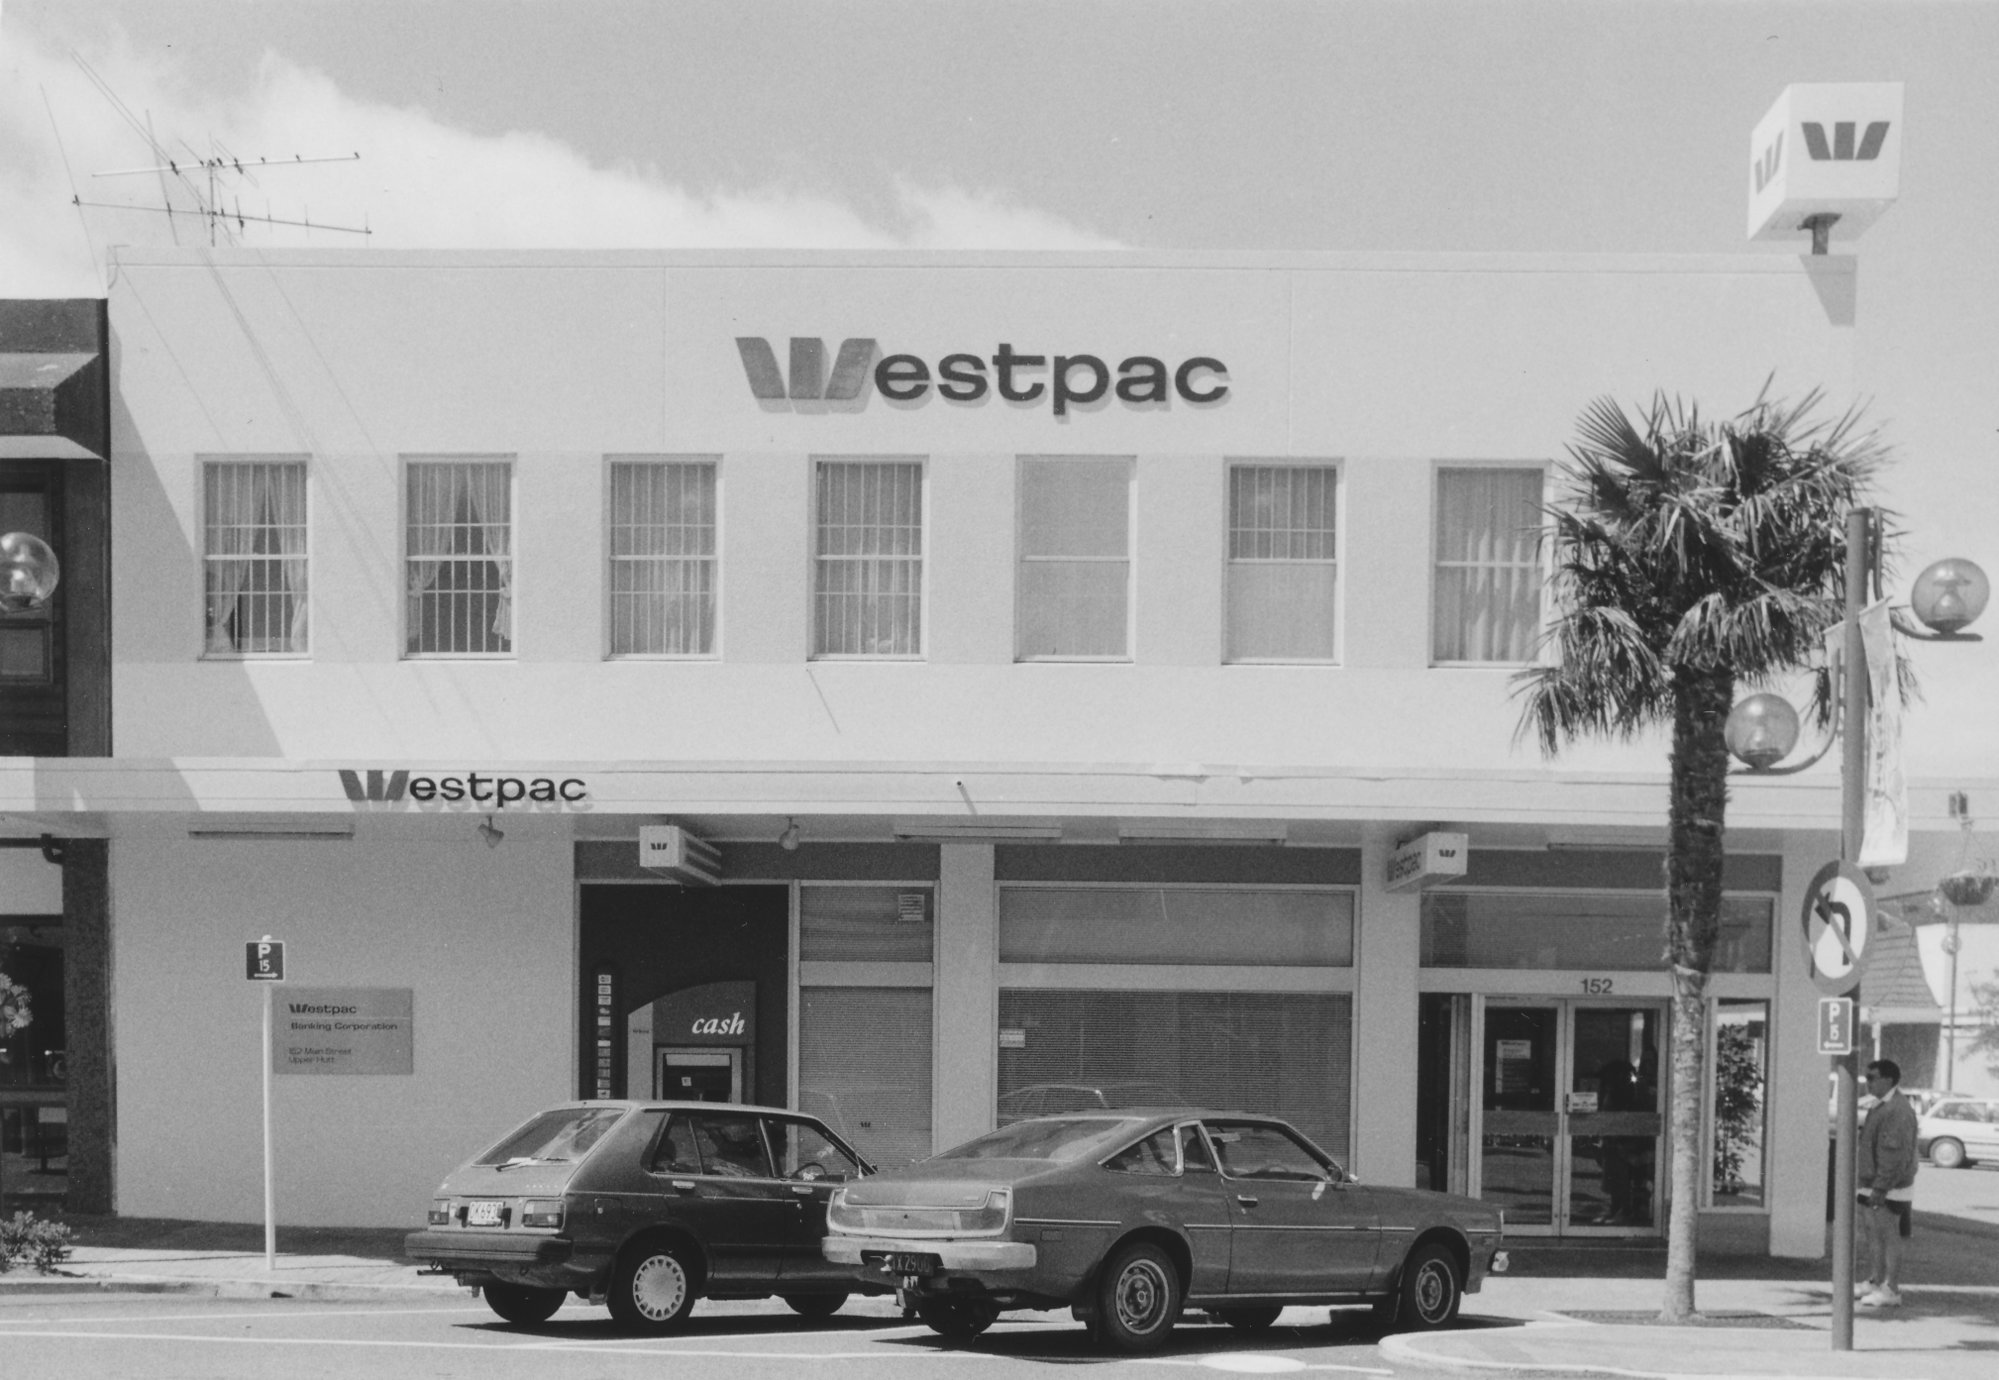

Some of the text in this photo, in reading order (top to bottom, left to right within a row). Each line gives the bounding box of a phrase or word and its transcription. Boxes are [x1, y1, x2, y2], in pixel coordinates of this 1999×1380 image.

[735, 337, 1229, 415] Westpac
[338, 770, 586, 808] Westpac
[258, 943, 271, 959] P
[259, 959, 270, 972] 15
[1581, 978, 1613, 994] 152
[289, 1003, 357, 1015] Westpac
[1829, 1002, 1840, 1023] P
[291, 1022, 398, 1031] Banking Corporation
[692, 1011, 745, 1035] cash
